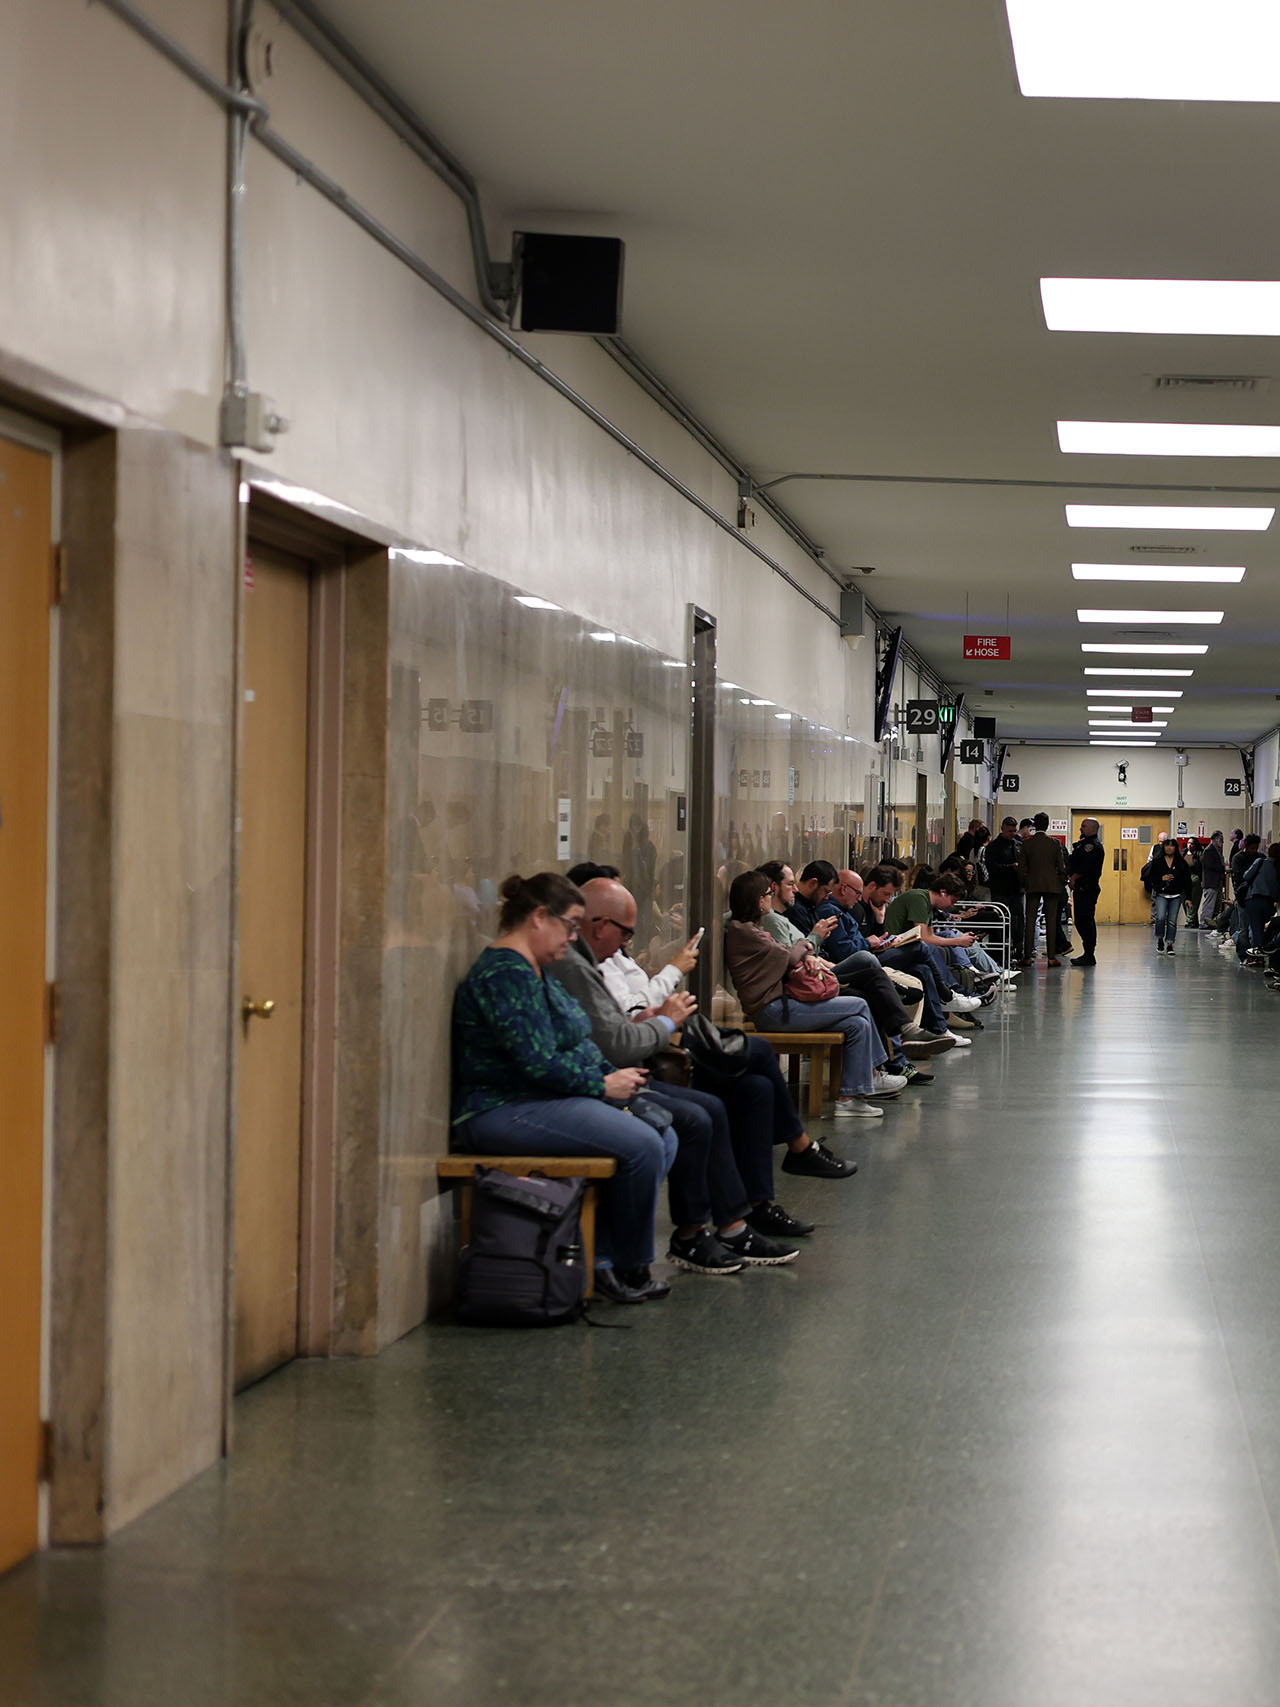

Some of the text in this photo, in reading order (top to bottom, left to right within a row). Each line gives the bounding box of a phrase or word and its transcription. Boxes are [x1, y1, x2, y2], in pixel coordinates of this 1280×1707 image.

[977, 638, 997, 646] FIRE
[974, 648, 1000, 657] HOSE
[910, 708, 936, 726] 29
[966, 745, 979, 758] 14
[1006, 778, 1016, 788] 13
[1226, 783, 1240, 792] 28
